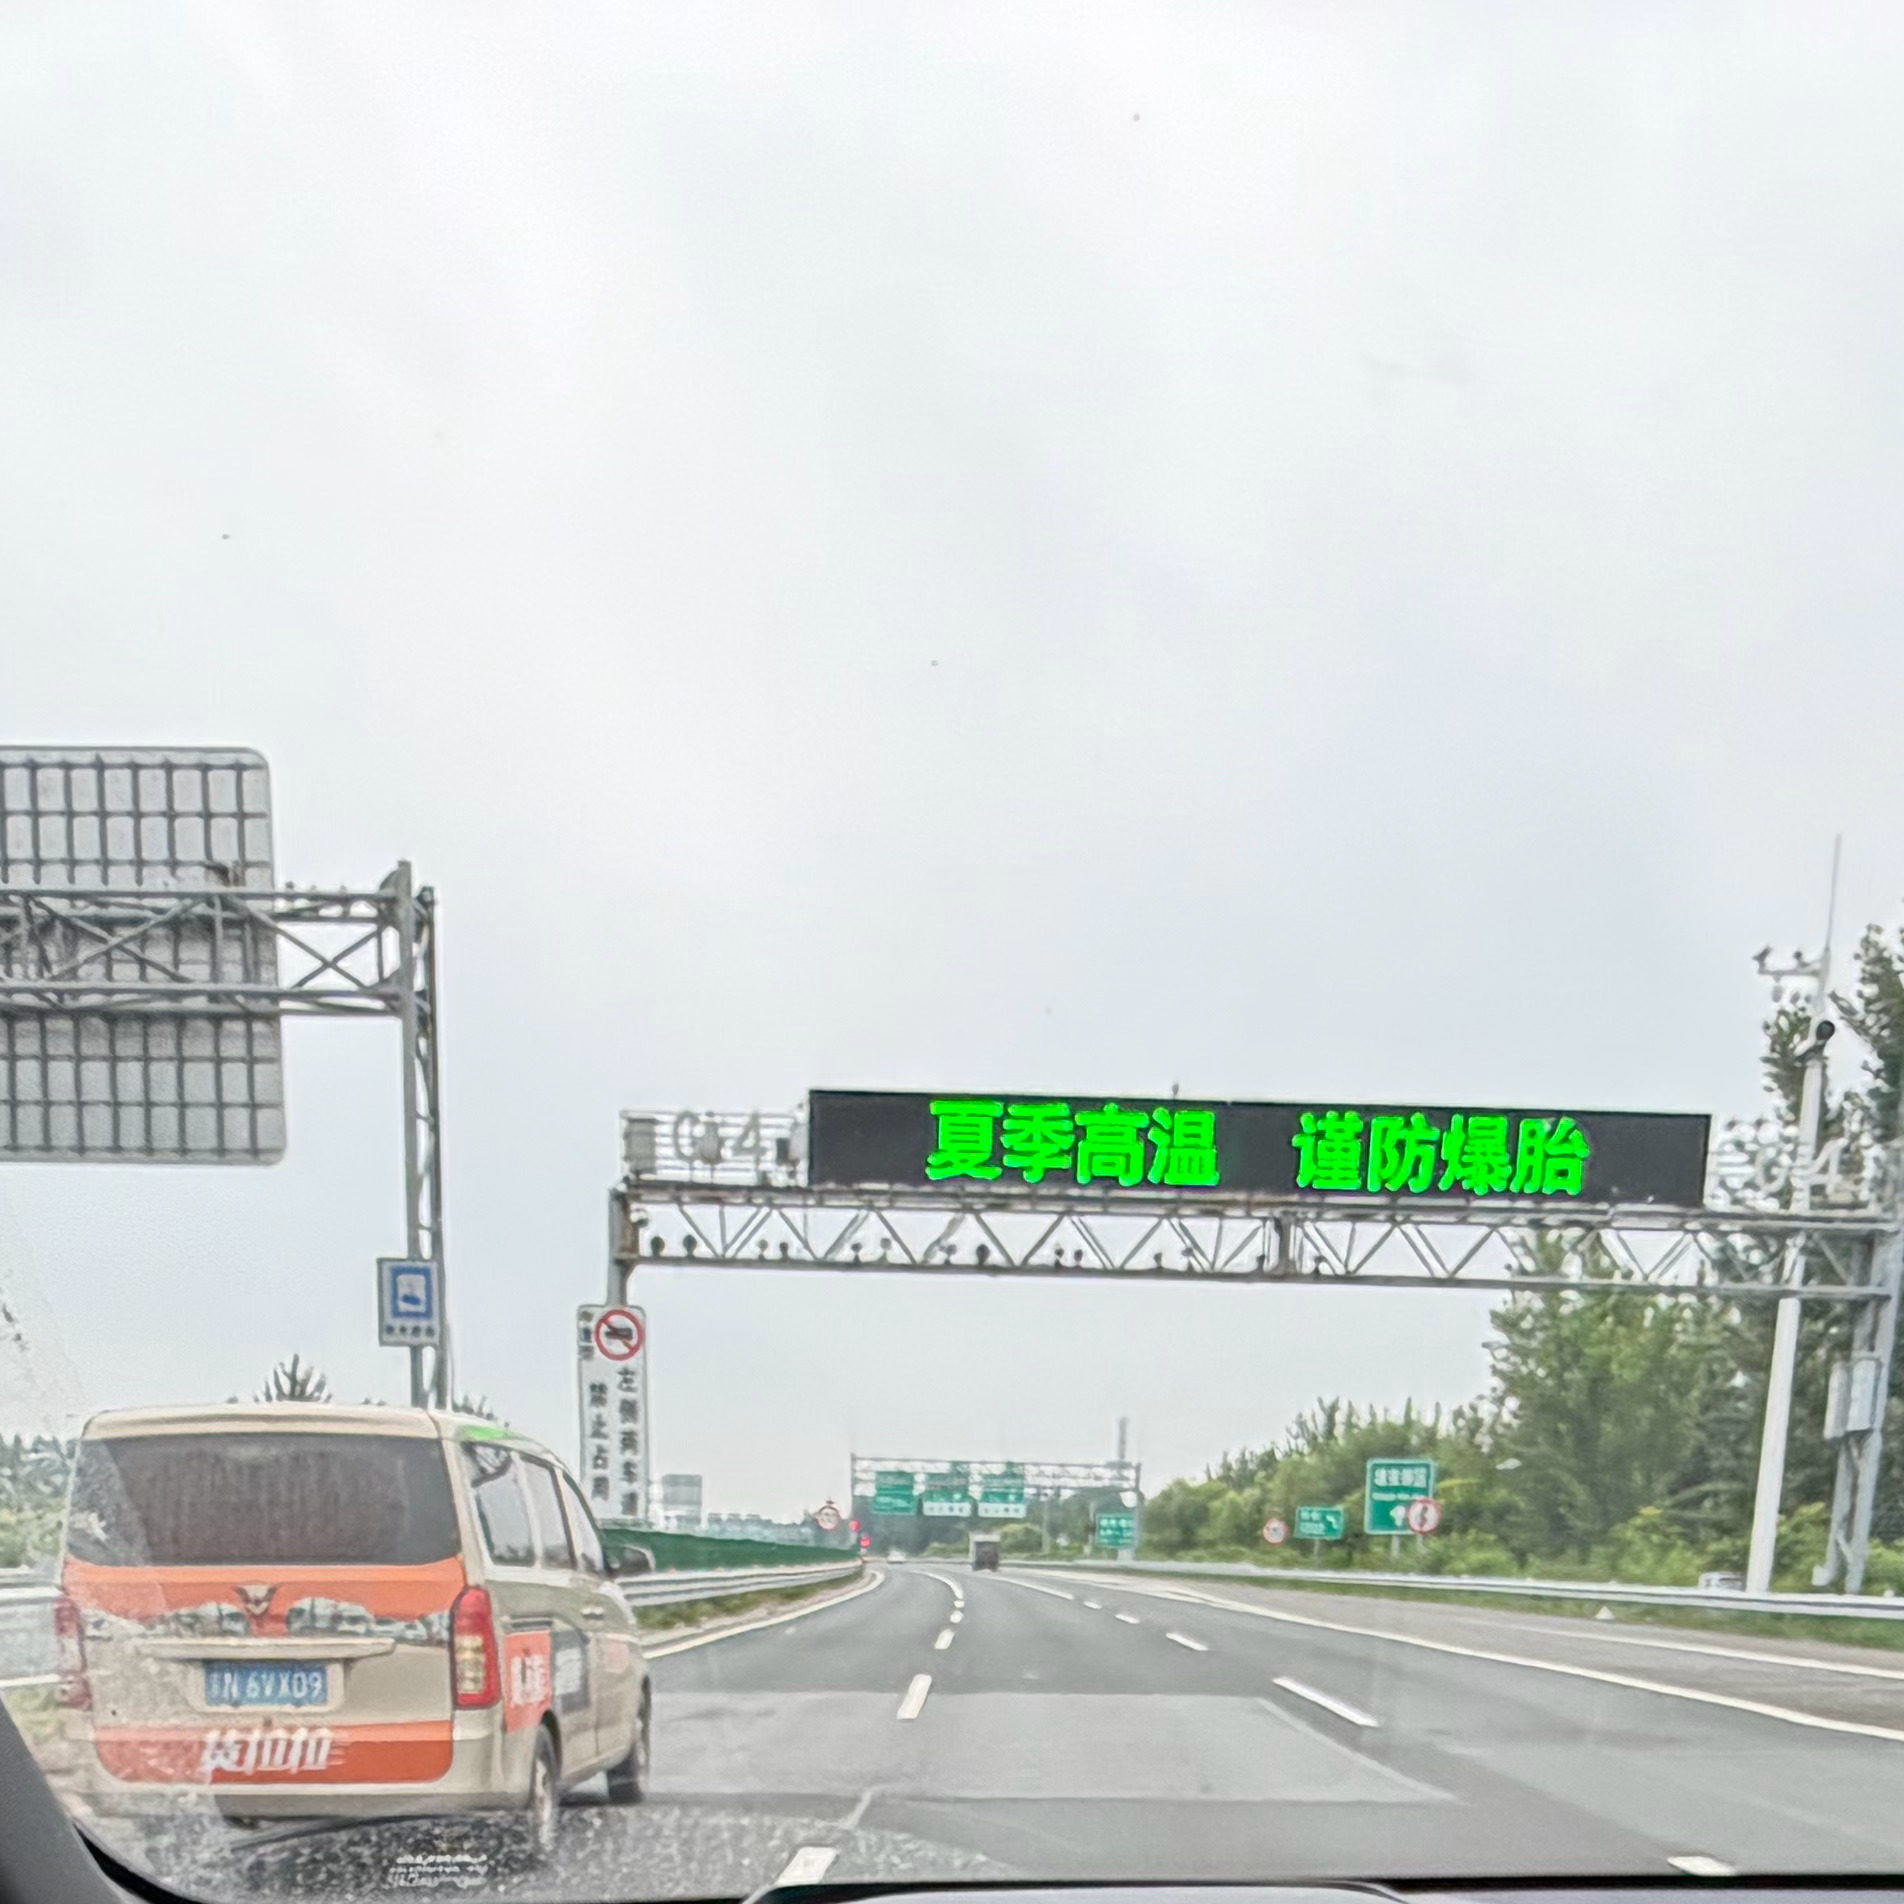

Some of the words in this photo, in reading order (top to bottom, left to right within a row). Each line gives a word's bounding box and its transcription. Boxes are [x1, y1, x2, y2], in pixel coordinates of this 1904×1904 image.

[926, 1101, 1219, 1185] 夏季高温
[1292, 1111, 1589, 1195] 谨防爆胎
